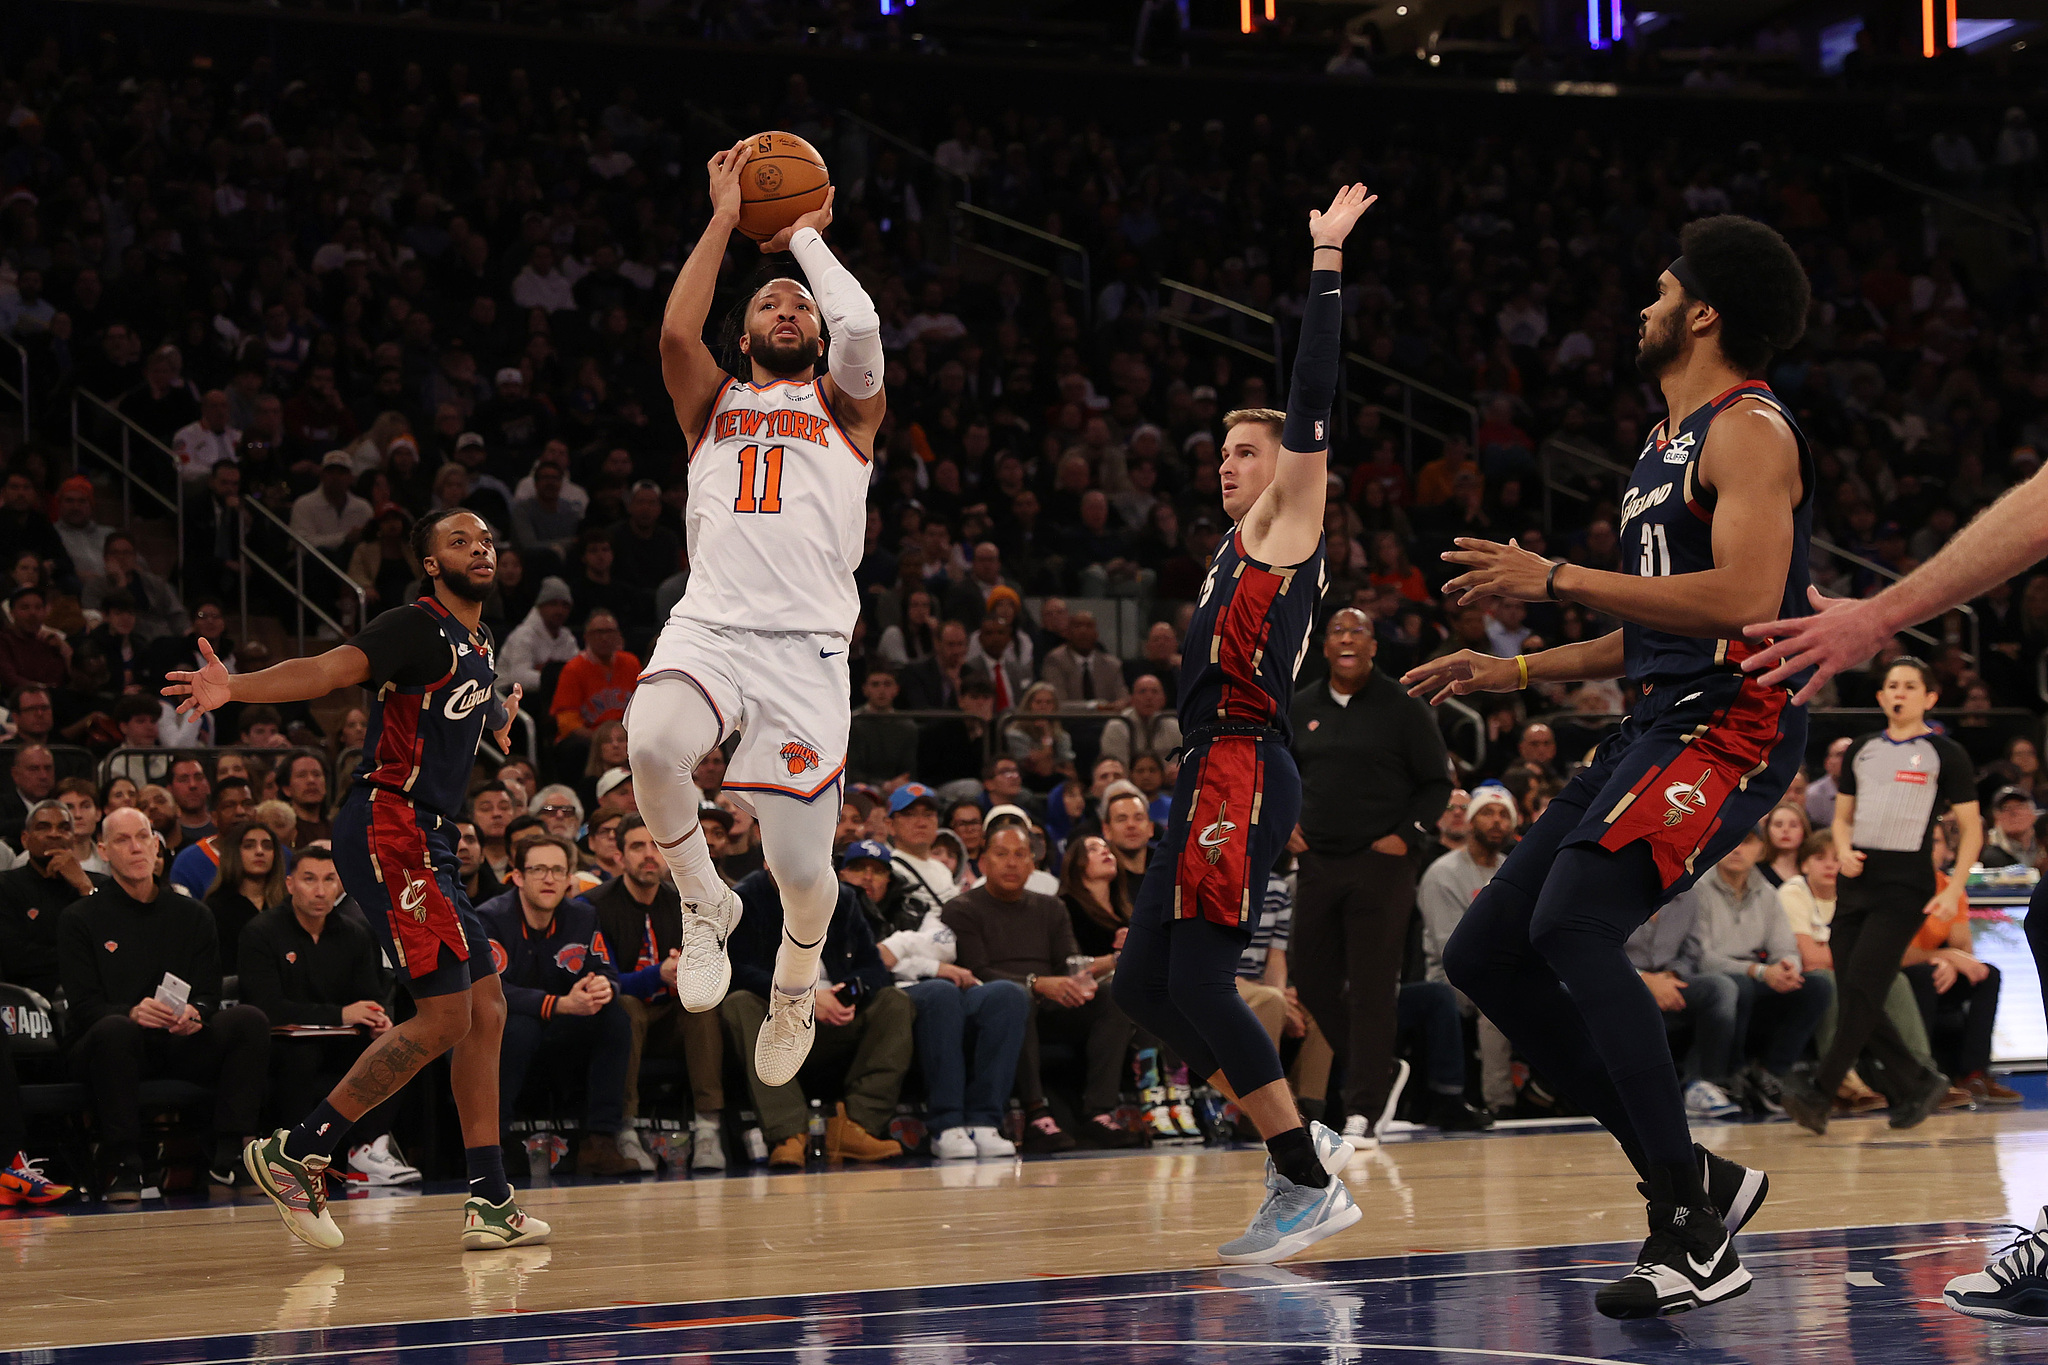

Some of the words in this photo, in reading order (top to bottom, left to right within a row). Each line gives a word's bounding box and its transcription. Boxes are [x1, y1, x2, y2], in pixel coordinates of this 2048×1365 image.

[714, 408, 767, 444] NEW
[764, 408, 830, 449] YORK
[1665, 451, 1688, 462] CLIFFS
[733, 444, 785, 514] 11
[1640, 522, 1671, 577] 31
[780, 741, 819, 768] KNICKS
[589, 930, 611, 964] 4
[18, 1005, 53, 1039] App
